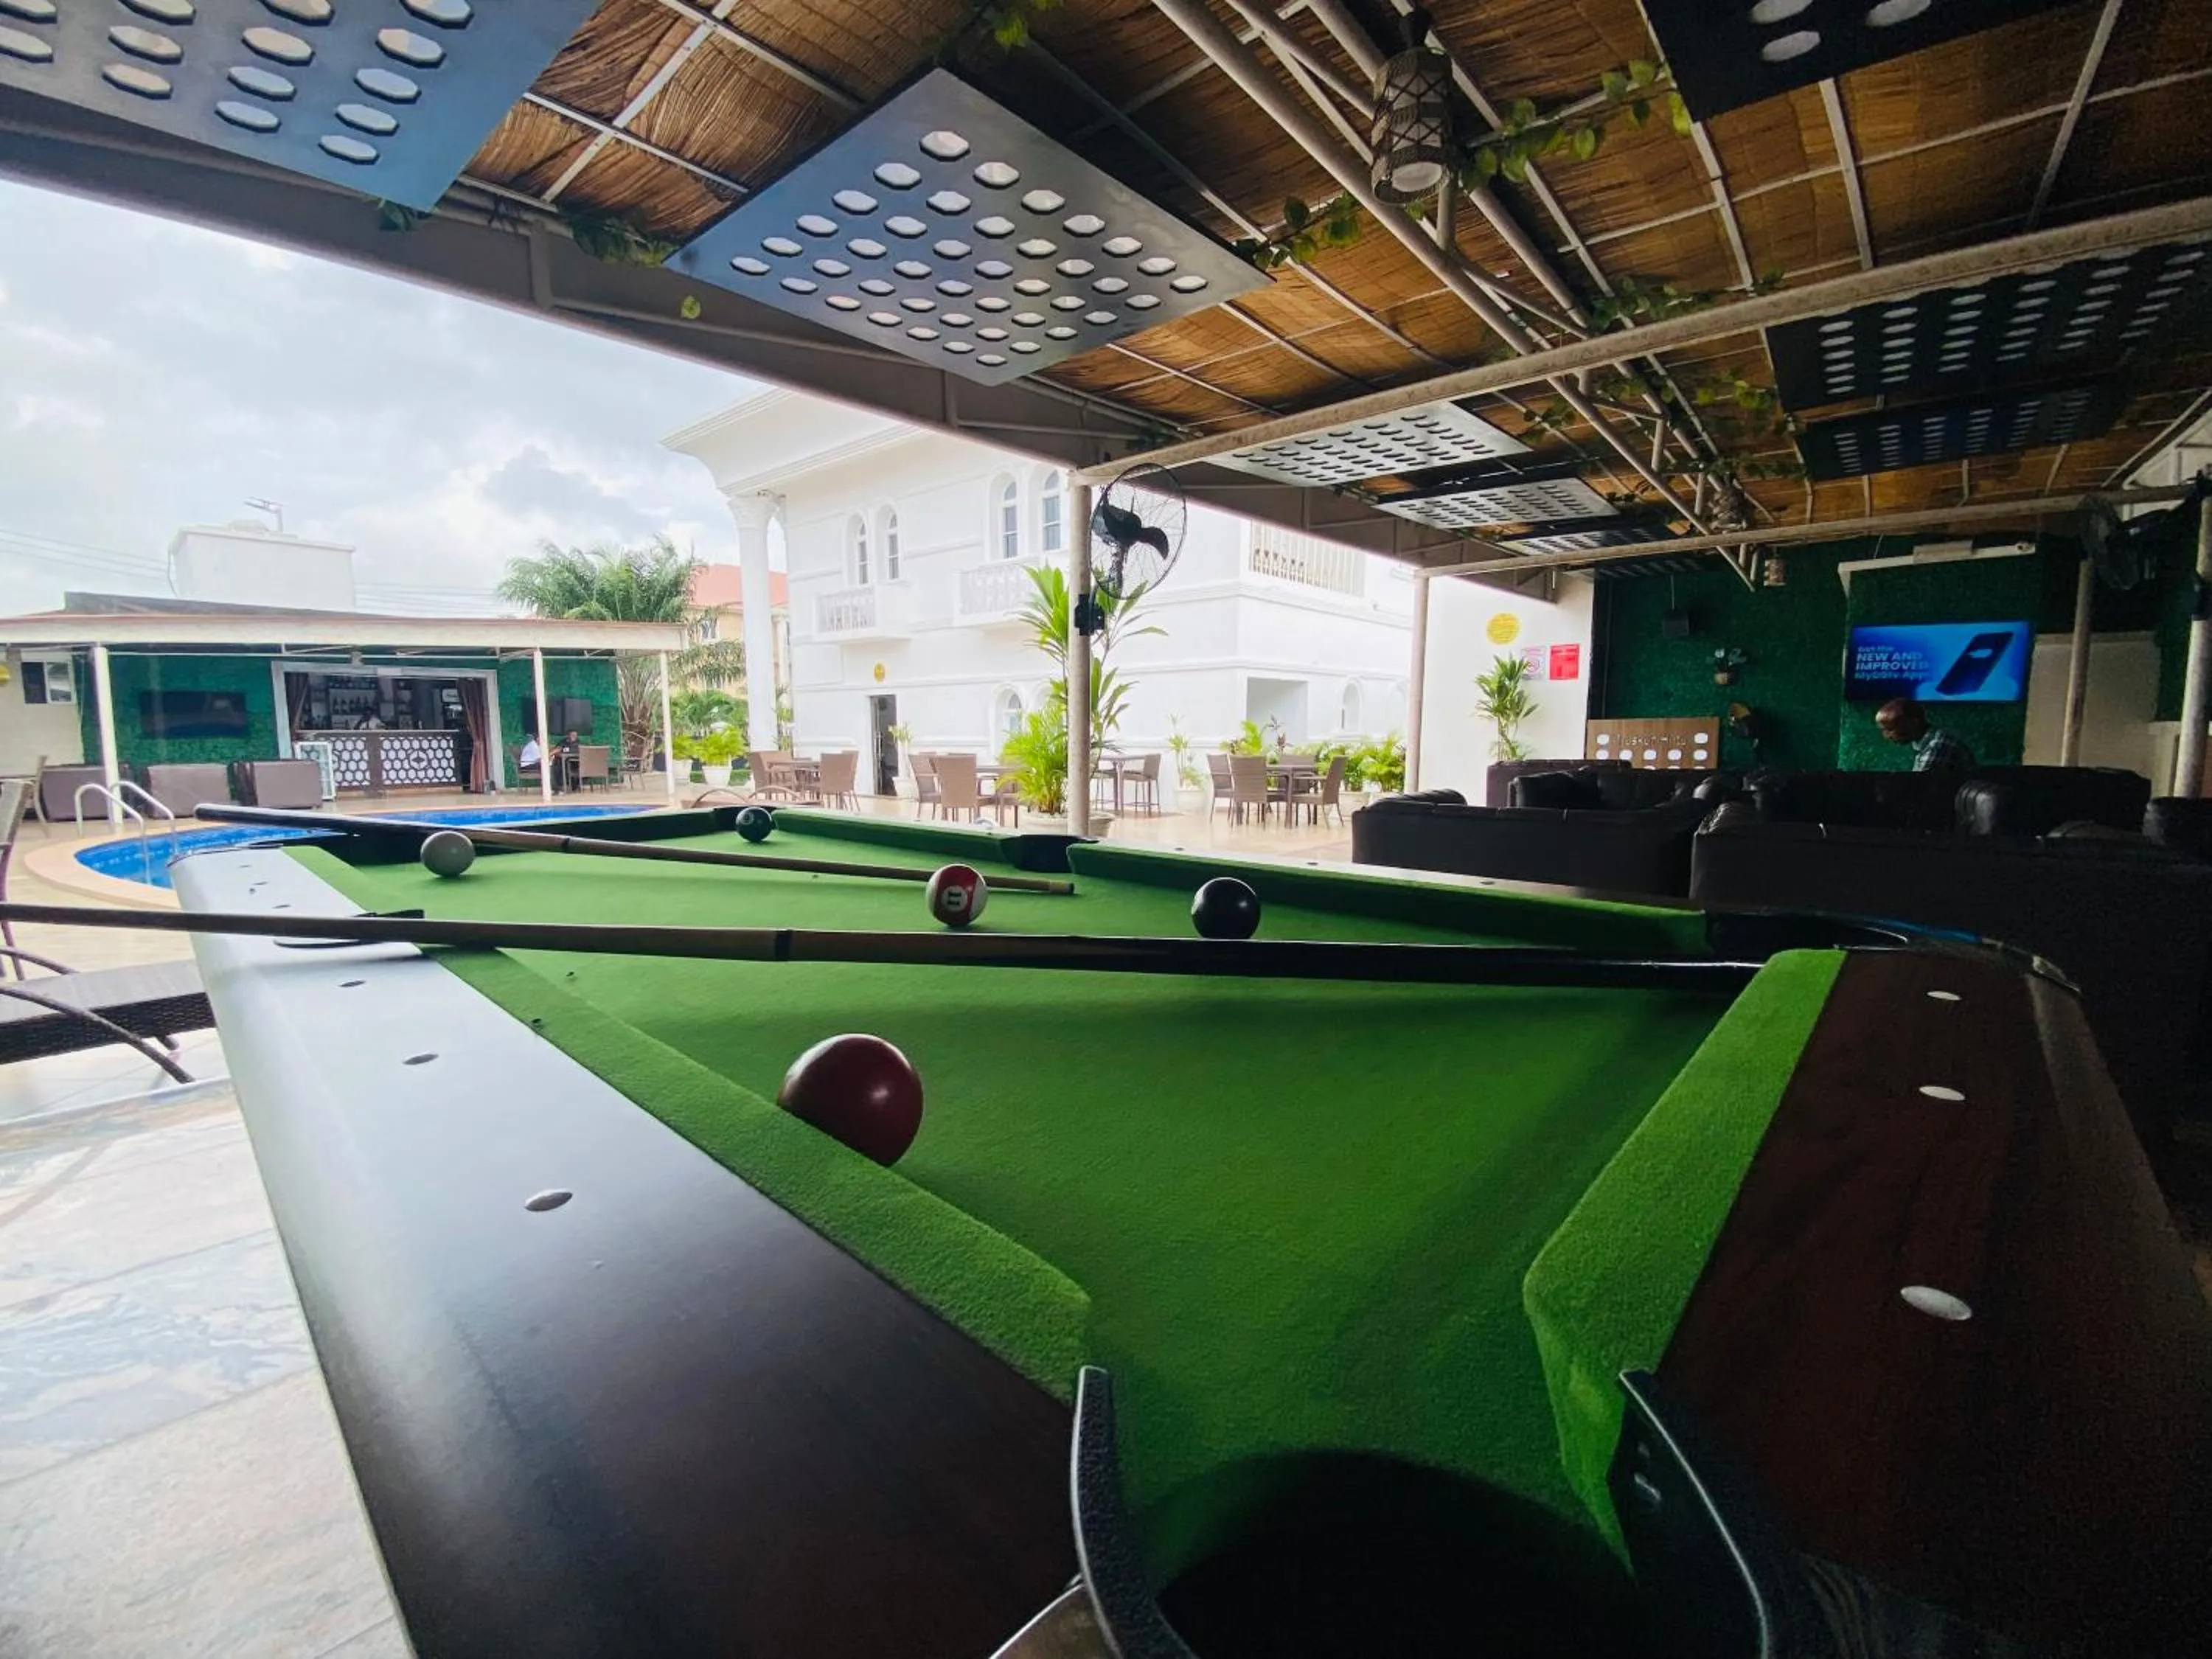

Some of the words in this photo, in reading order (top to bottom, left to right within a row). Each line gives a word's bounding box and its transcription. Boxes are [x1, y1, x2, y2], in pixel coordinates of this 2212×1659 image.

[1857, 653, 1888, 661] NEW
[1891, 652, 1923, 661] AND
[1855, 661, 1929, 670] IMPROVED
